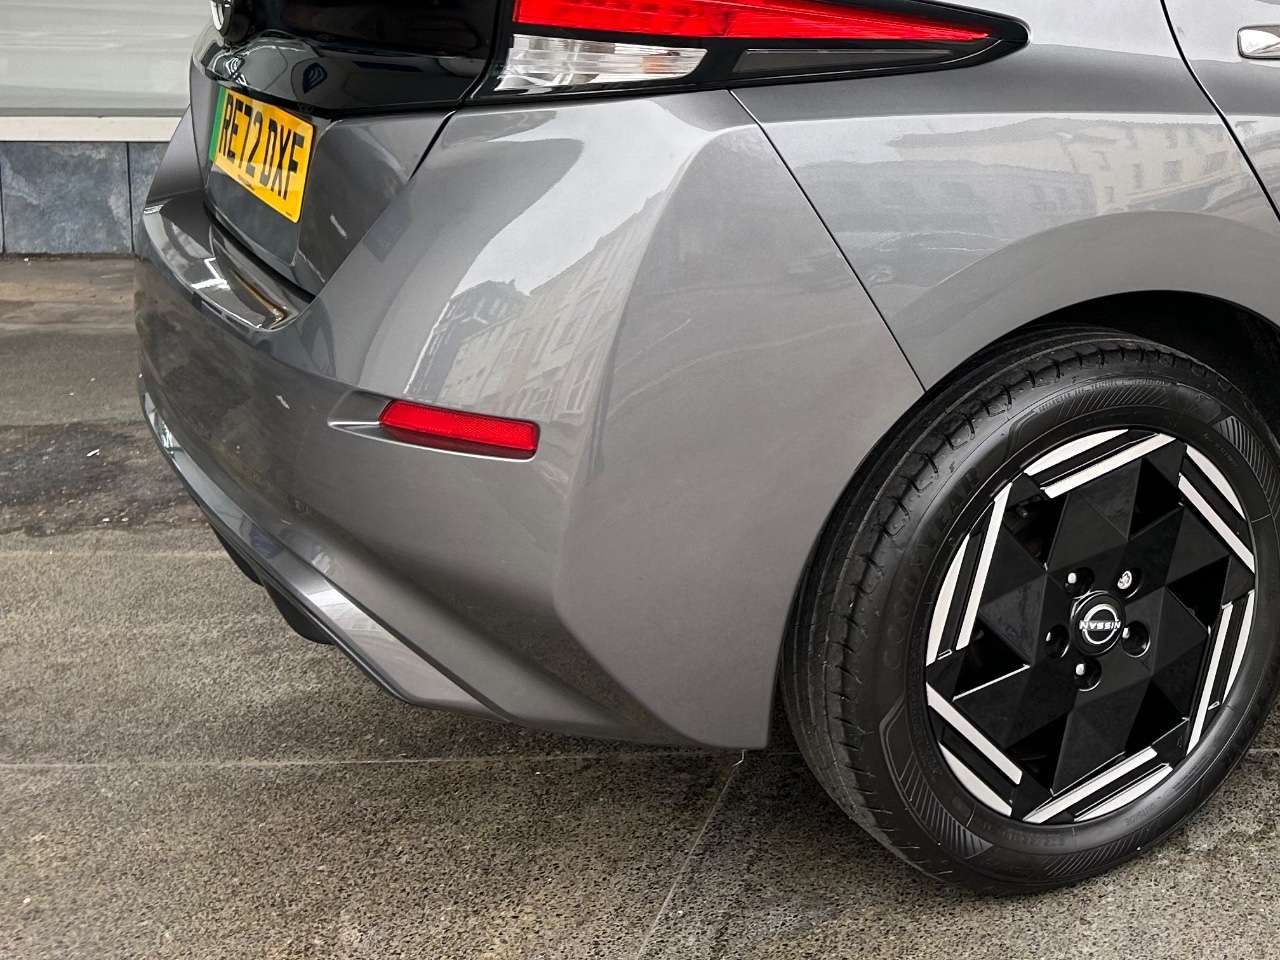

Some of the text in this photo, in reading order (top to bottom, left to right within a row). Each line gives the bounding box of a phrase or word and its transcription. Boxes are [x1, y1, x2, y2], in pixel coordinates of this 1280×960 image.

[218, 94, 305, 200] RE72 DXF
[1079, 620, 1121, 631] NISSAN
